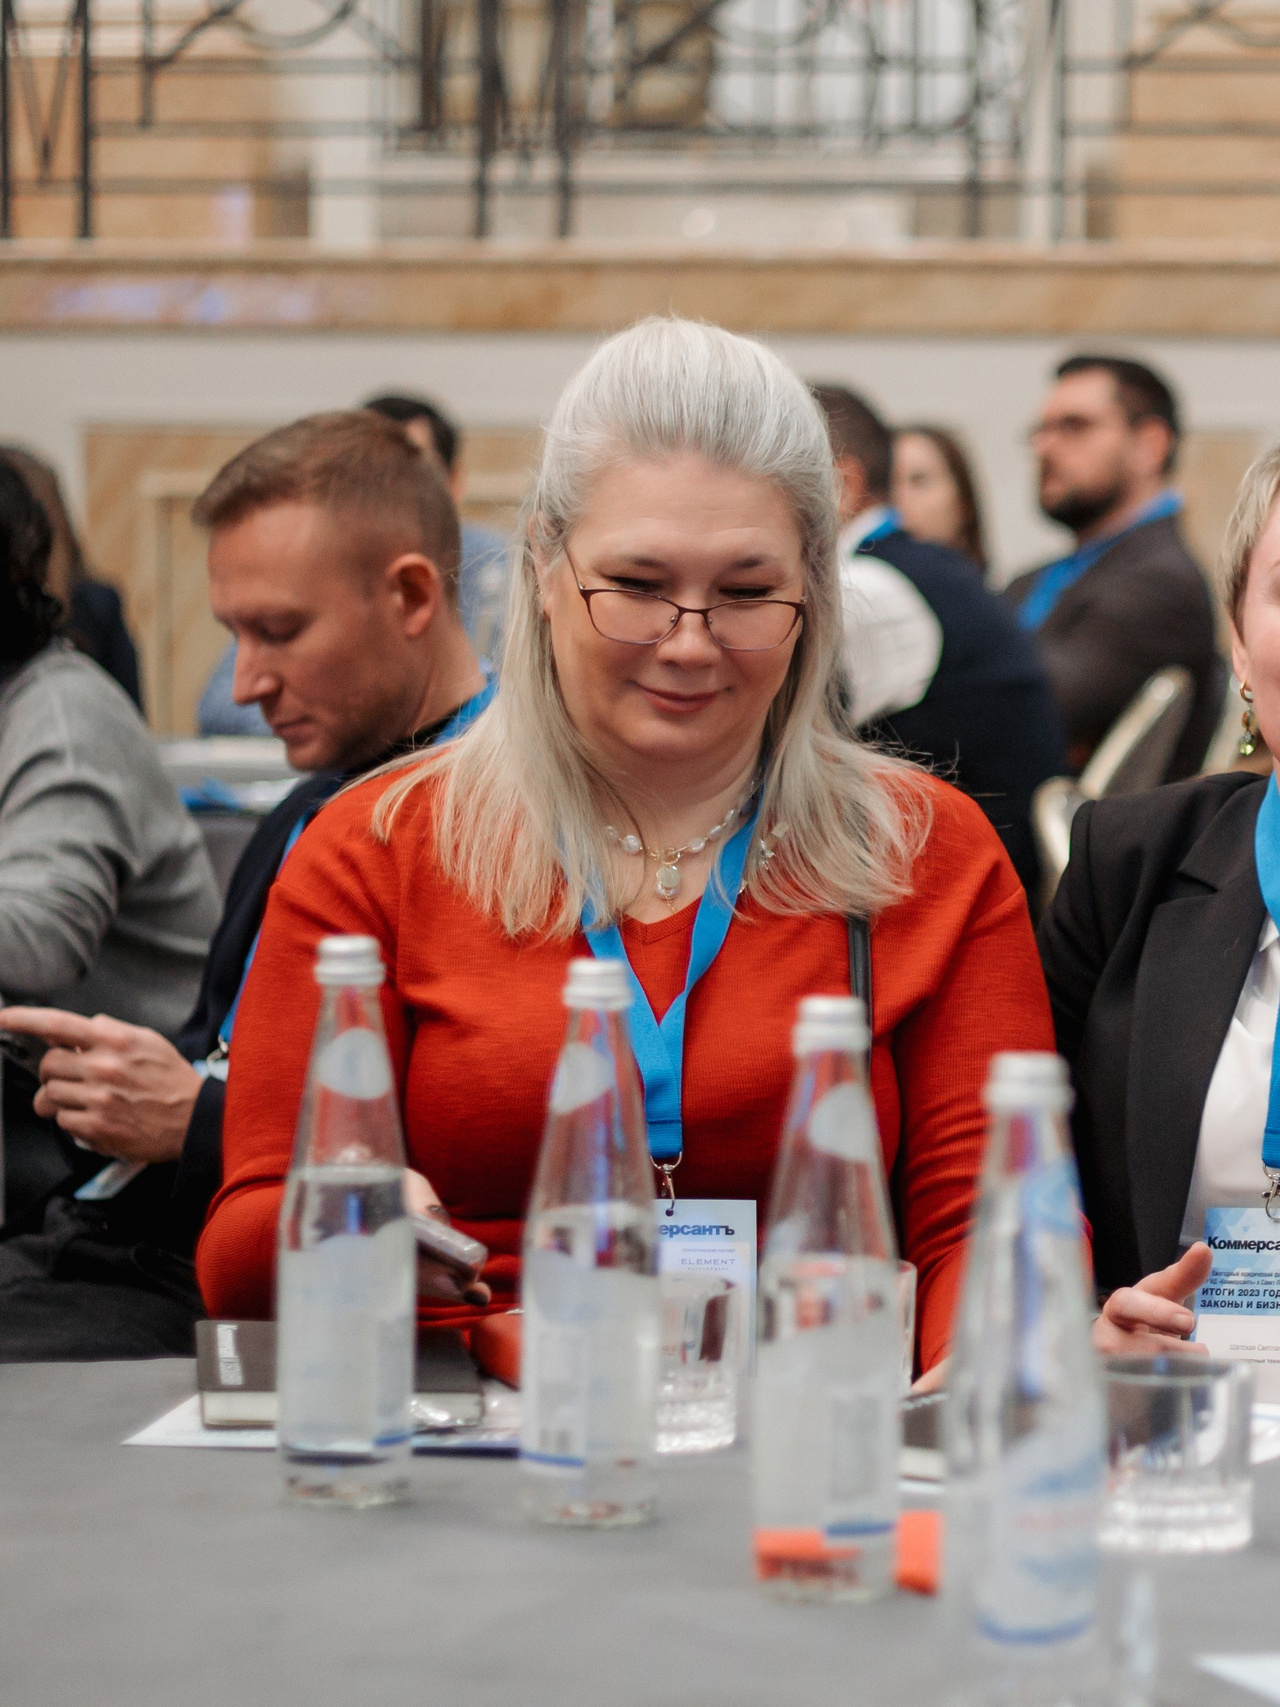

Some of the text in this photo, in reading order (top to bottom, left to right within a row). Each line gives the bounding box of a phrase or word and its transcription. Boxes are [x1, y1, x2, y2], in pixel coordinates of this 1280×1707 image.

[659, 1224, 736, 1239] ерсантъ
[681, 1258, 736, 1266] ELEMENT
[1201, 1288, 1235, 1297] ИТОГИ
[1237, 1288, 1260, 1297] 2023
[1200, 1299, 1244, 1309] ЗАКОНЫ
[1246, 1300, 1253, 1309] И
